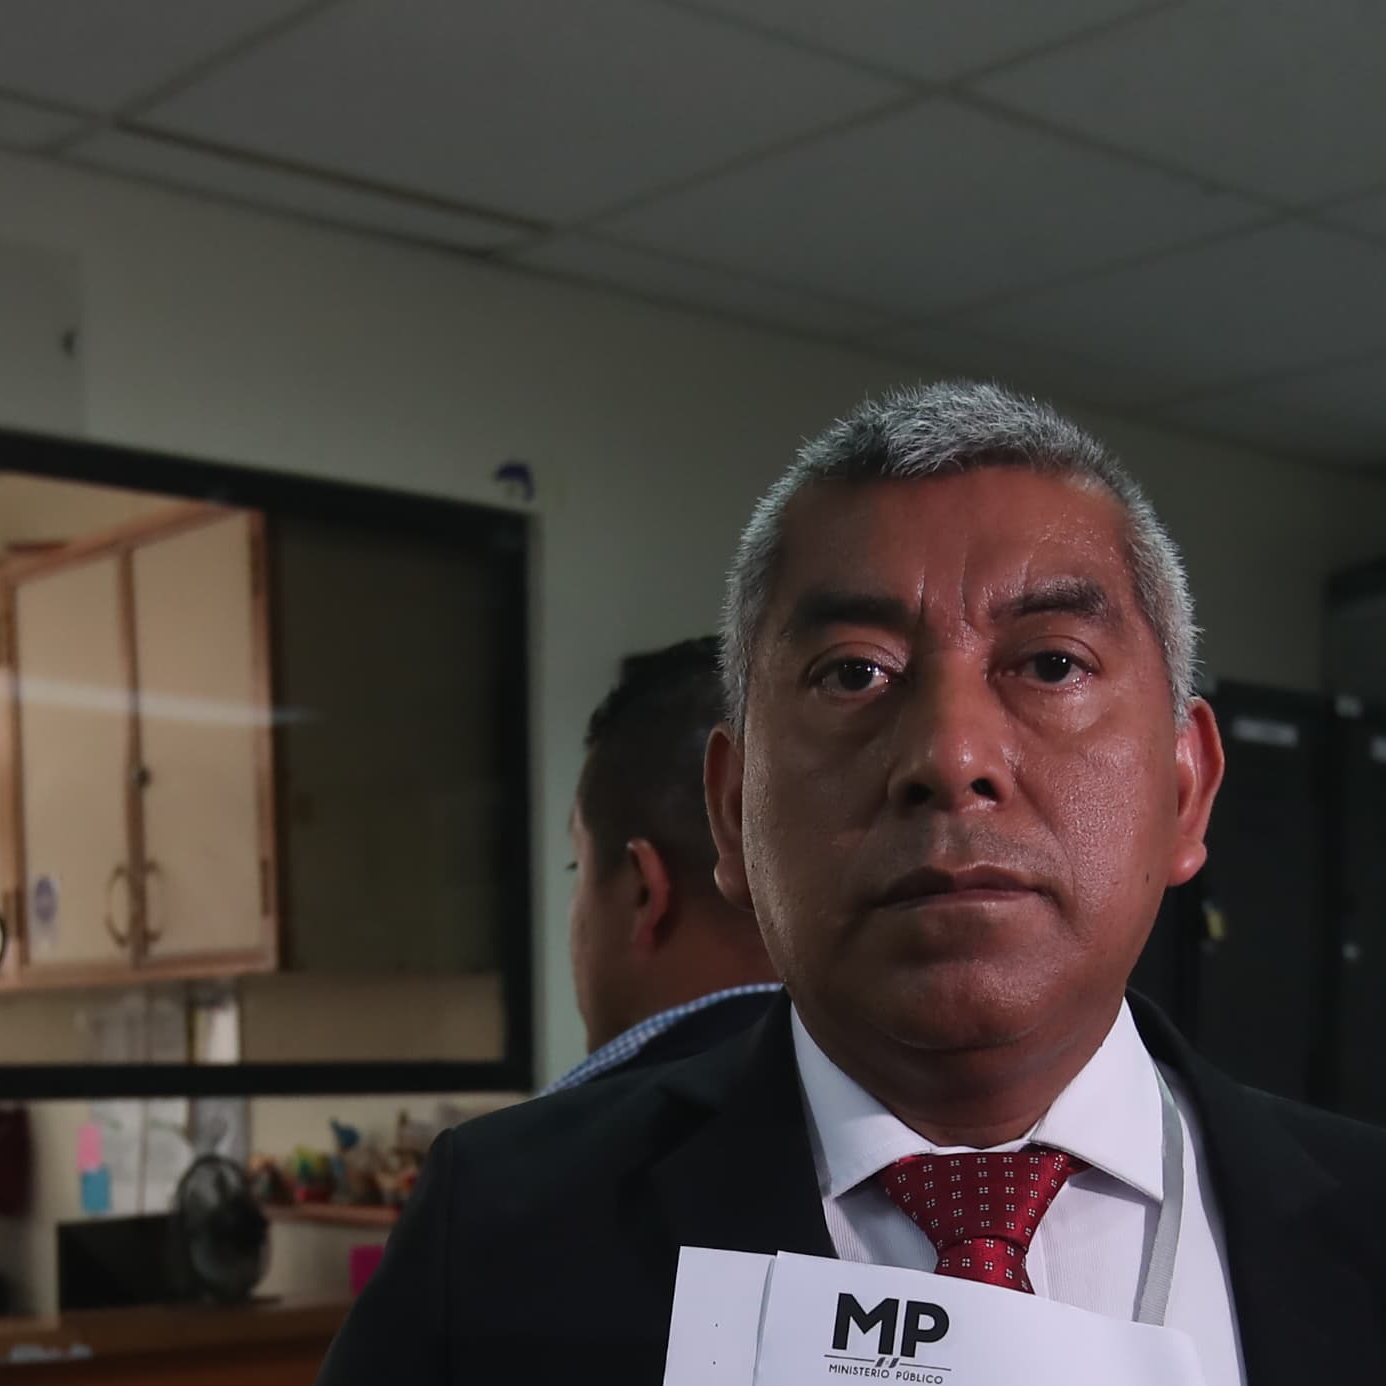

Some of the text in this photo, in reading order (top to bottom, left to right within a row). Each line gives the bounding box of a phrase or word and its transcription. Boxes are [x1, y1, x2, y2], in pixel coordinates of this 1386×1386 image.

[832, 1292, 950, 1358] MP
[829, 1364, 944, 1385] MINISTERIO PÚBLICO
